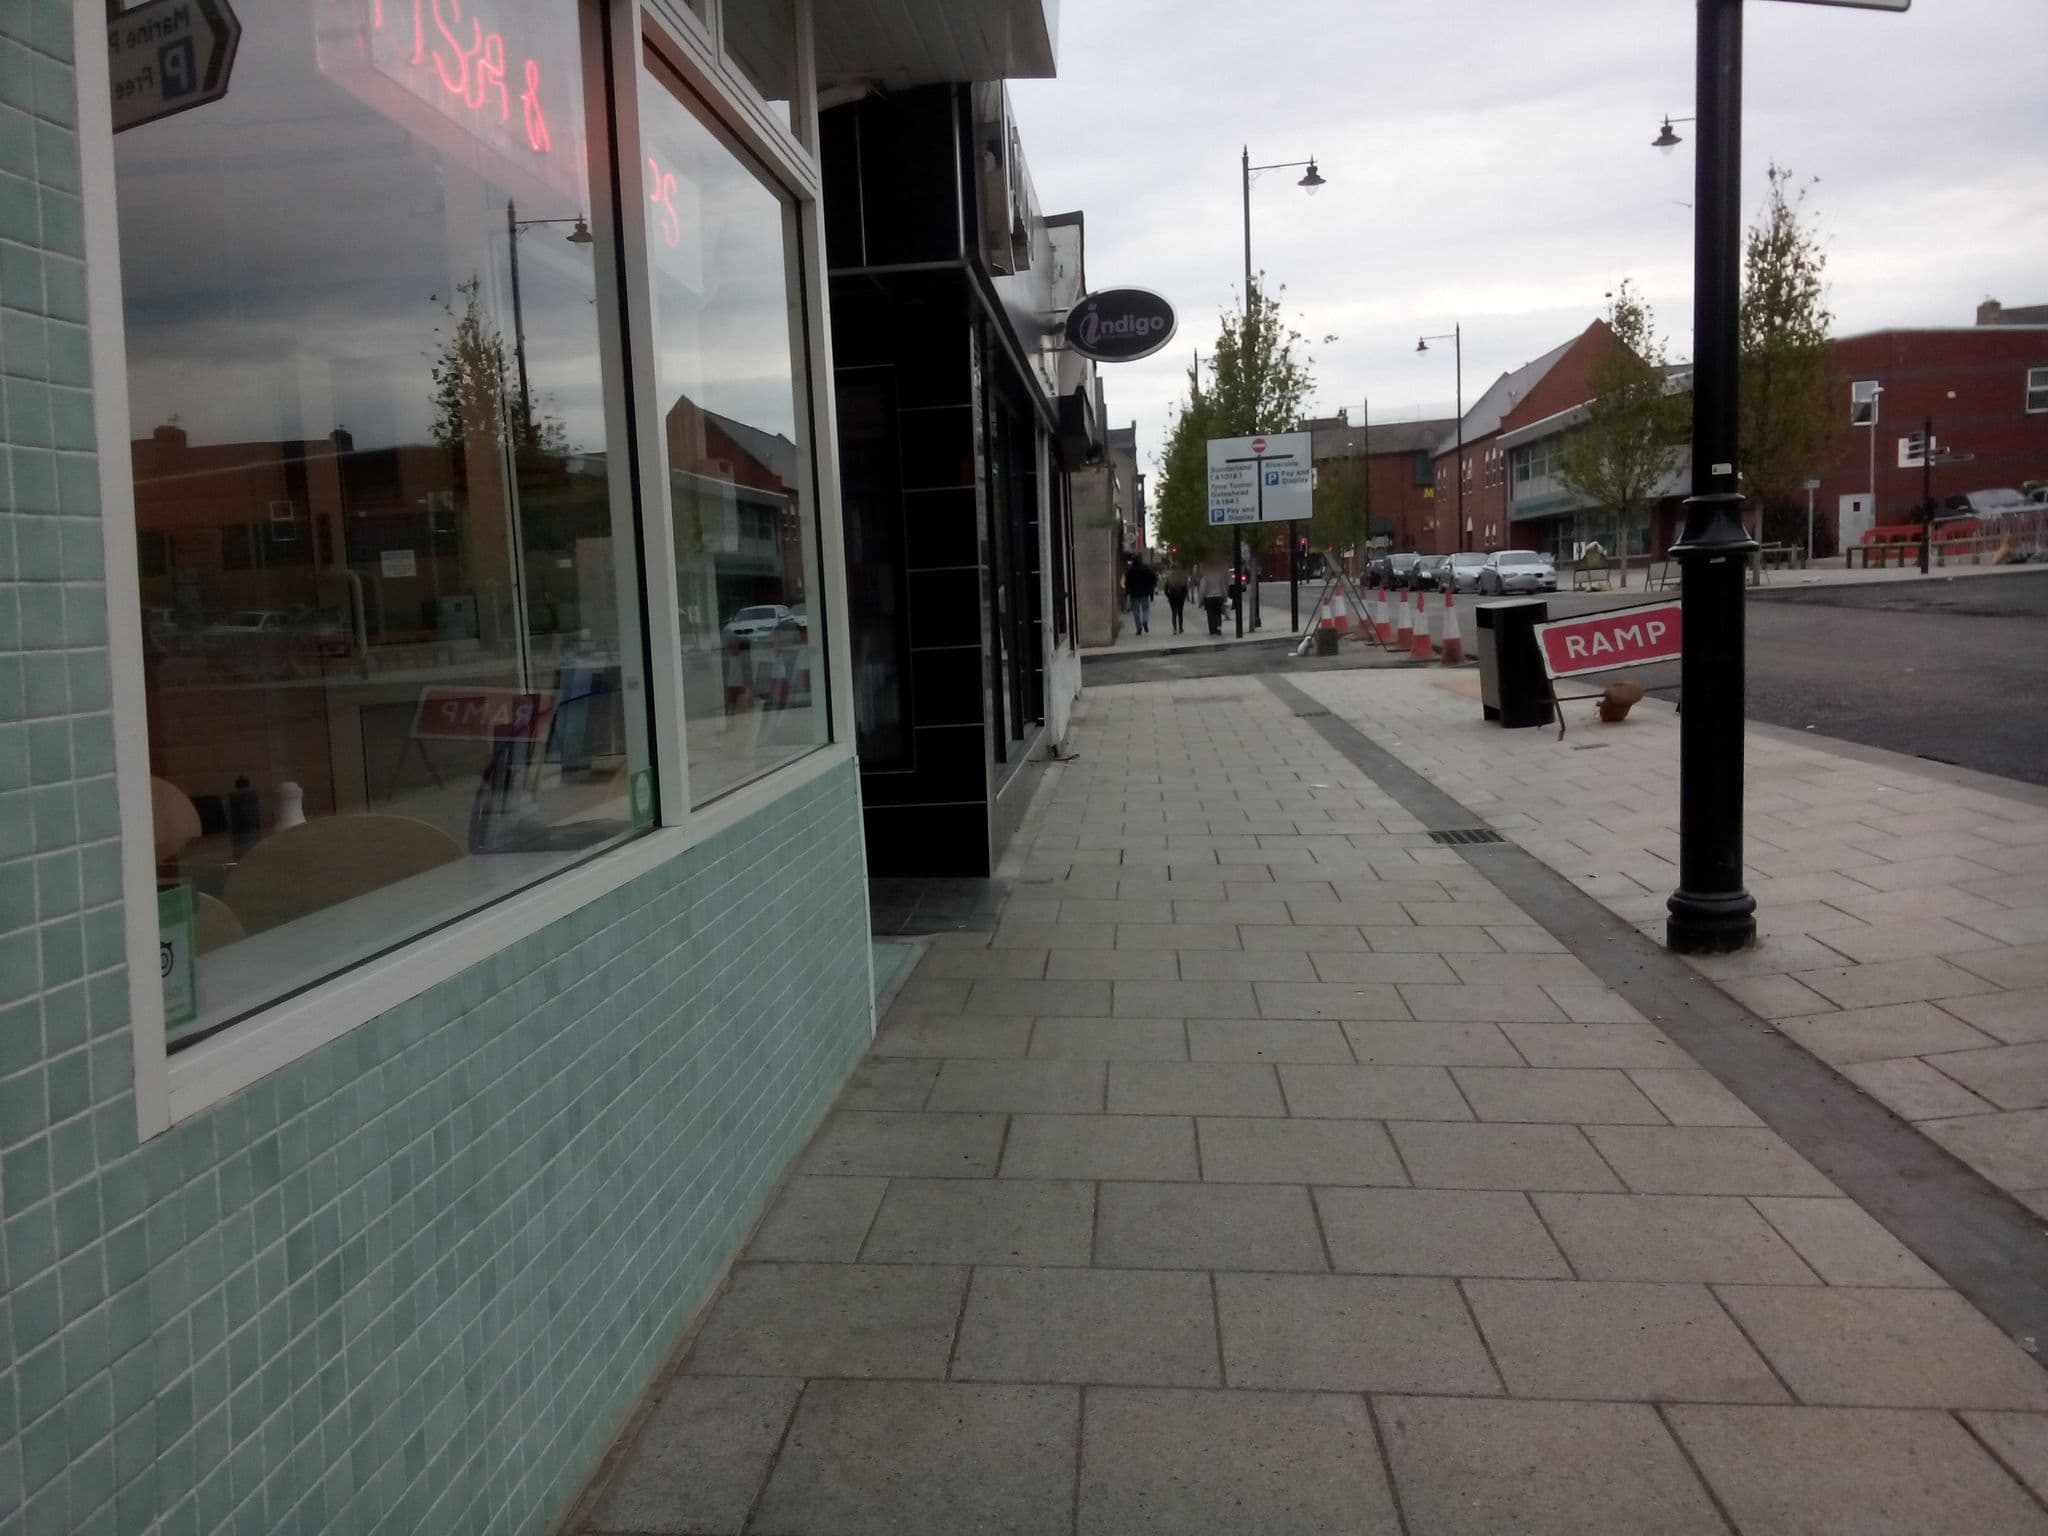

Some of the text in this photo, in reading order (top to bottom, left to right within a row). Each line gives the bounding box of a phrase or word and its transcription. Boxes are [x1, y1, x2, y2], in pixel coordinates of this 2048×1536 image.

[1281, 471, 1294, 479] Pay
[1282, 476, 1308, 486] Display
[1211, 489, 1249, 498] Gateshead
[1226, 507, 1241, 515] Pay
[1228, 512, 1254, 522] Display
[1565, 621, 1666, 659] RAMP
